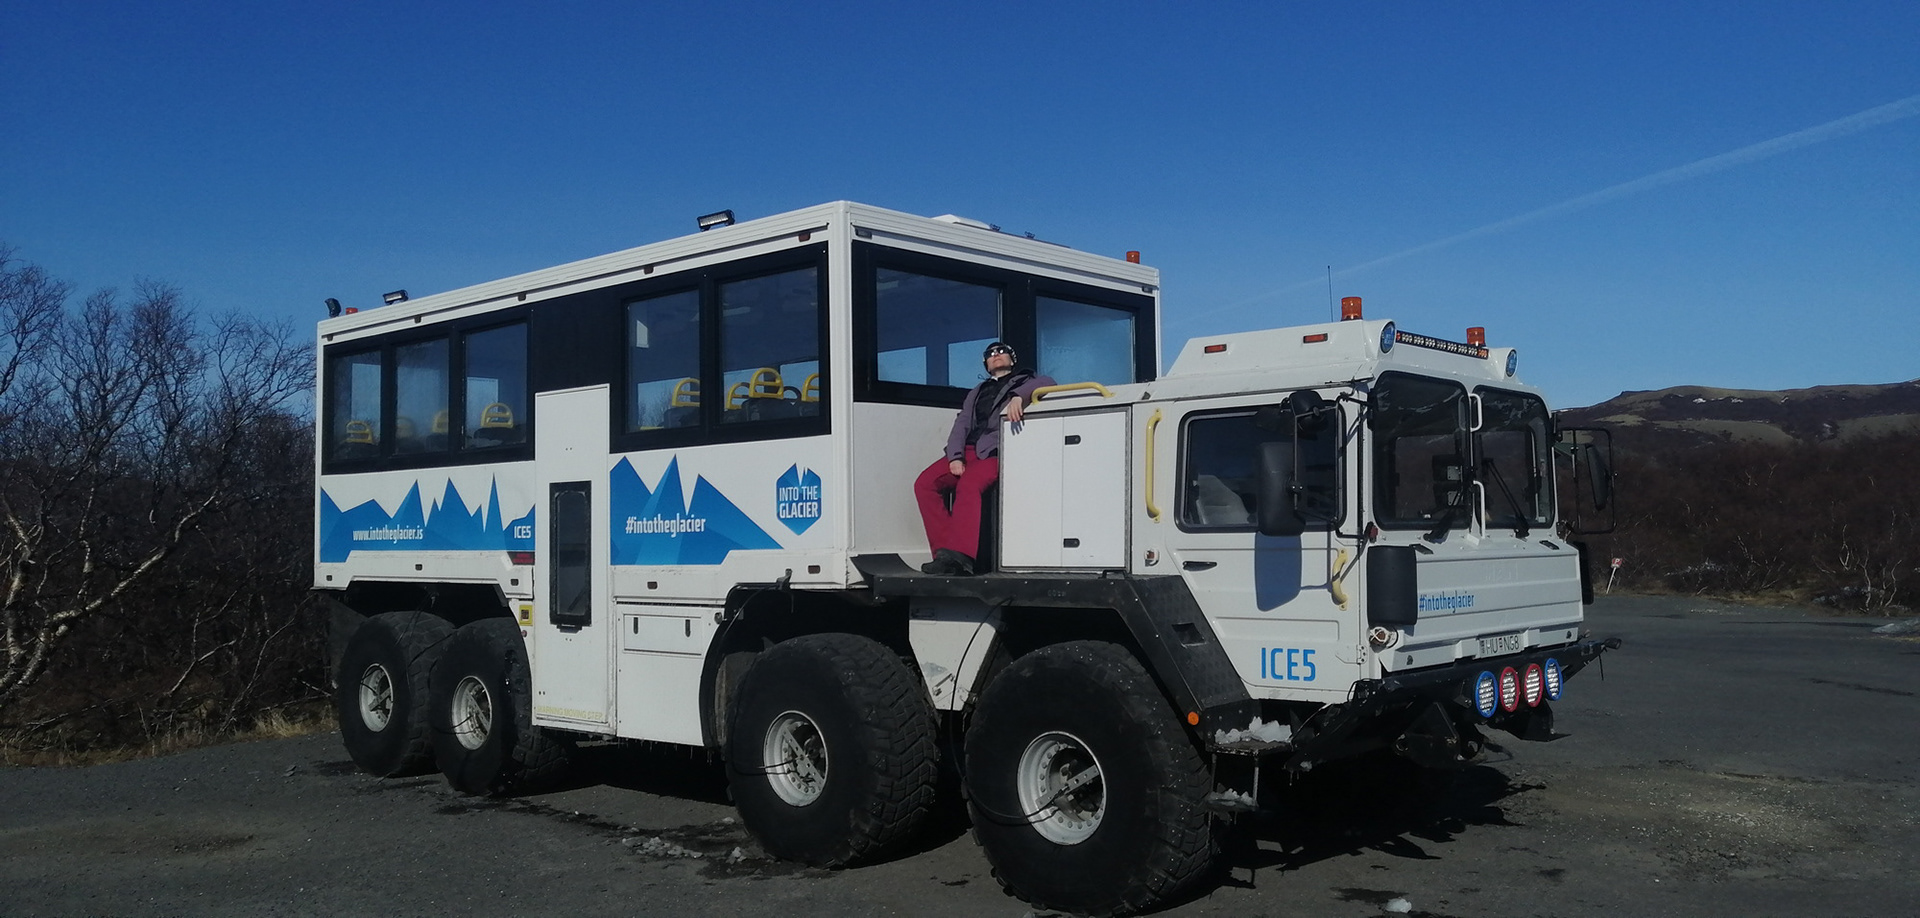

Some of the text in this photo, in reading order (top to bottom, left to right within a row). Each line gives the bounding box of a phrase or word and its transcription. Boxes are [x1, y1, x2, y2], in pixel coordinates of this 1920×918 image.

[779, 486, 818, 501] INTO THE
[779, 502, 818, 518] GLACIER
[353, 524, 423, 544] www.intotheglacier.is
[513, 525, 531, 538] ICE5
[625, 512, 706, 538] #intotheglacier
[1419, 590, 1474, 613] #intotheglacier
[1261, 647, 1316, 681] ICE5
